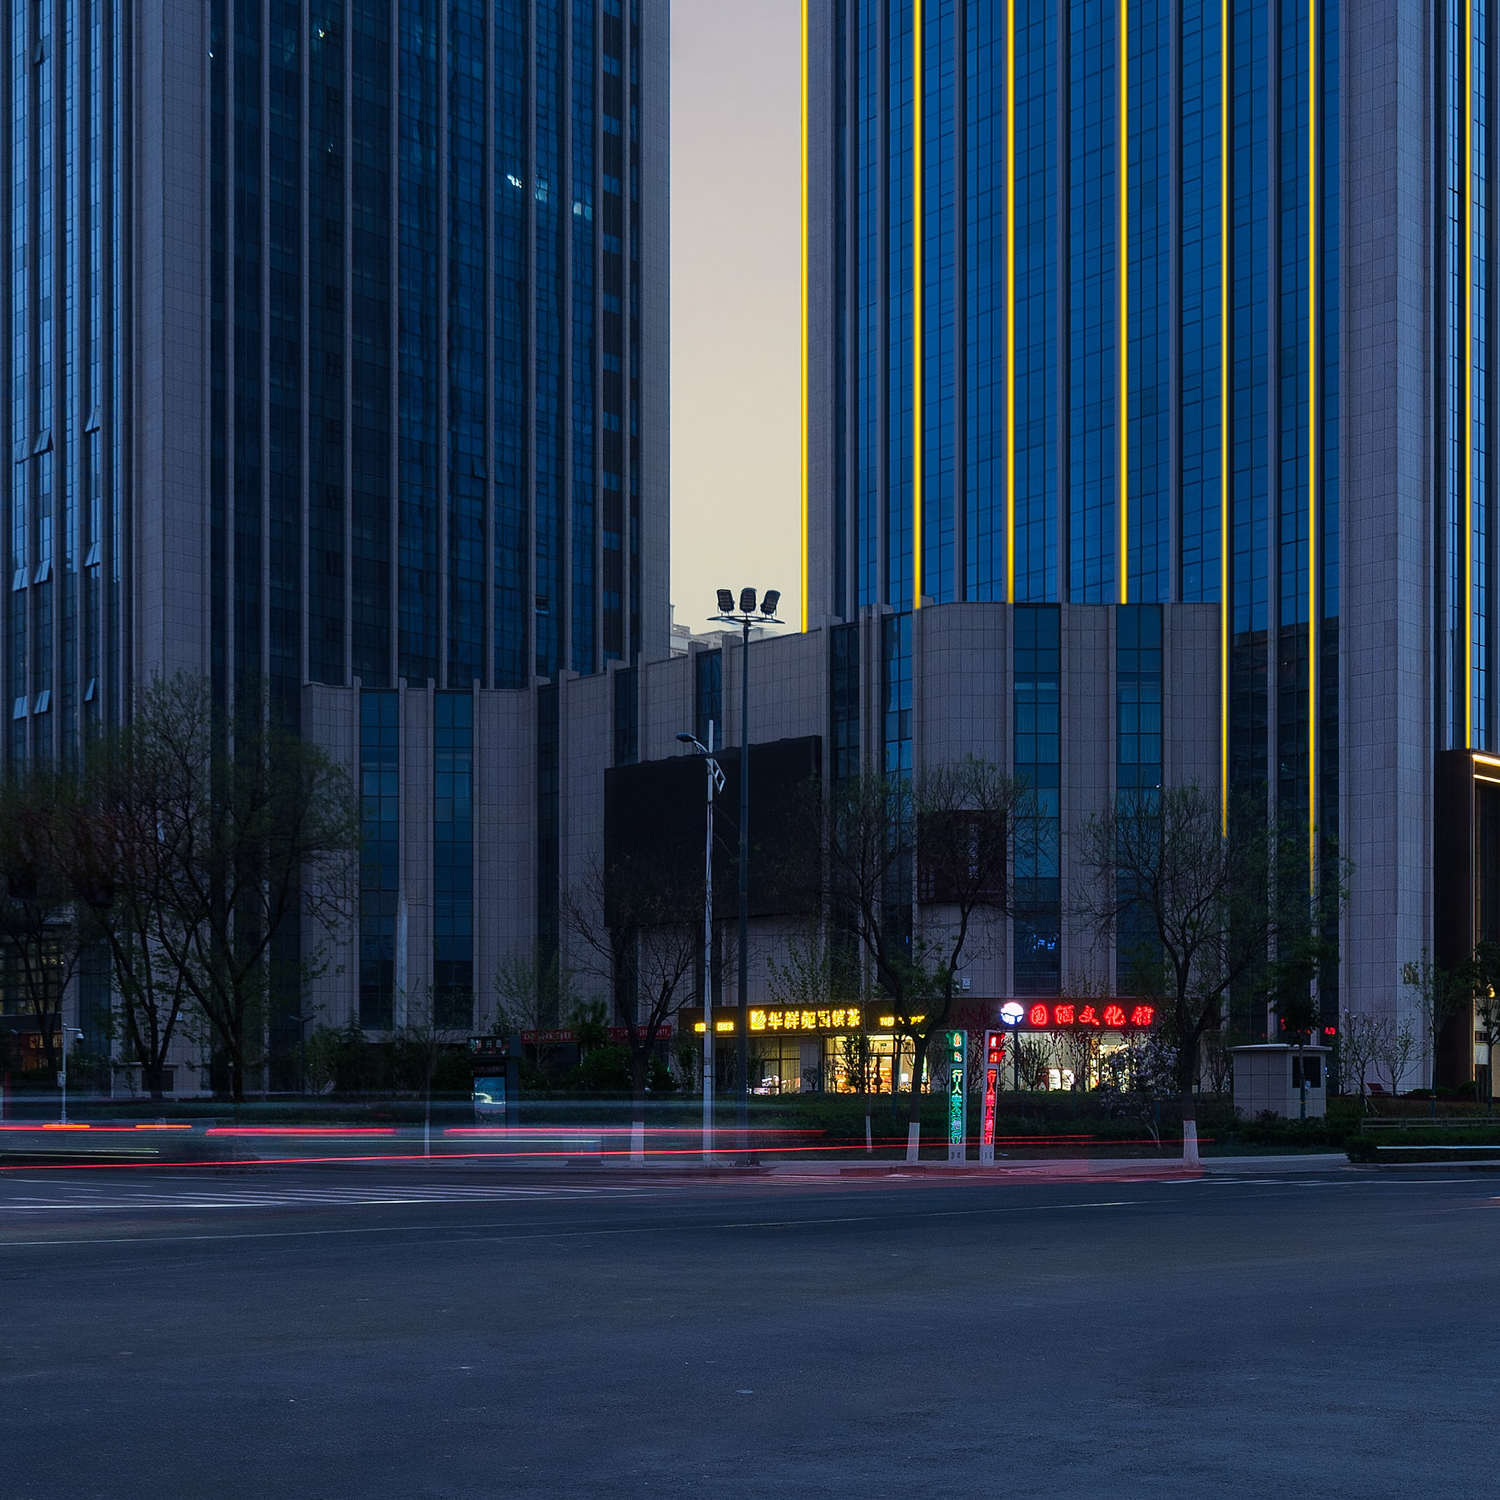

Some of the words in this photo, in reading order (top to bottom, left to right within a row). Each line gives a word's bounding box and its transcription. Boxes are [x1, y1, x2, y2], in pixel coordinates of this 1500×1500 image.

[951, 1069, 963, 1145] 行人安全通行
[985, 1069, 997, 1145] 行人禁止通行
